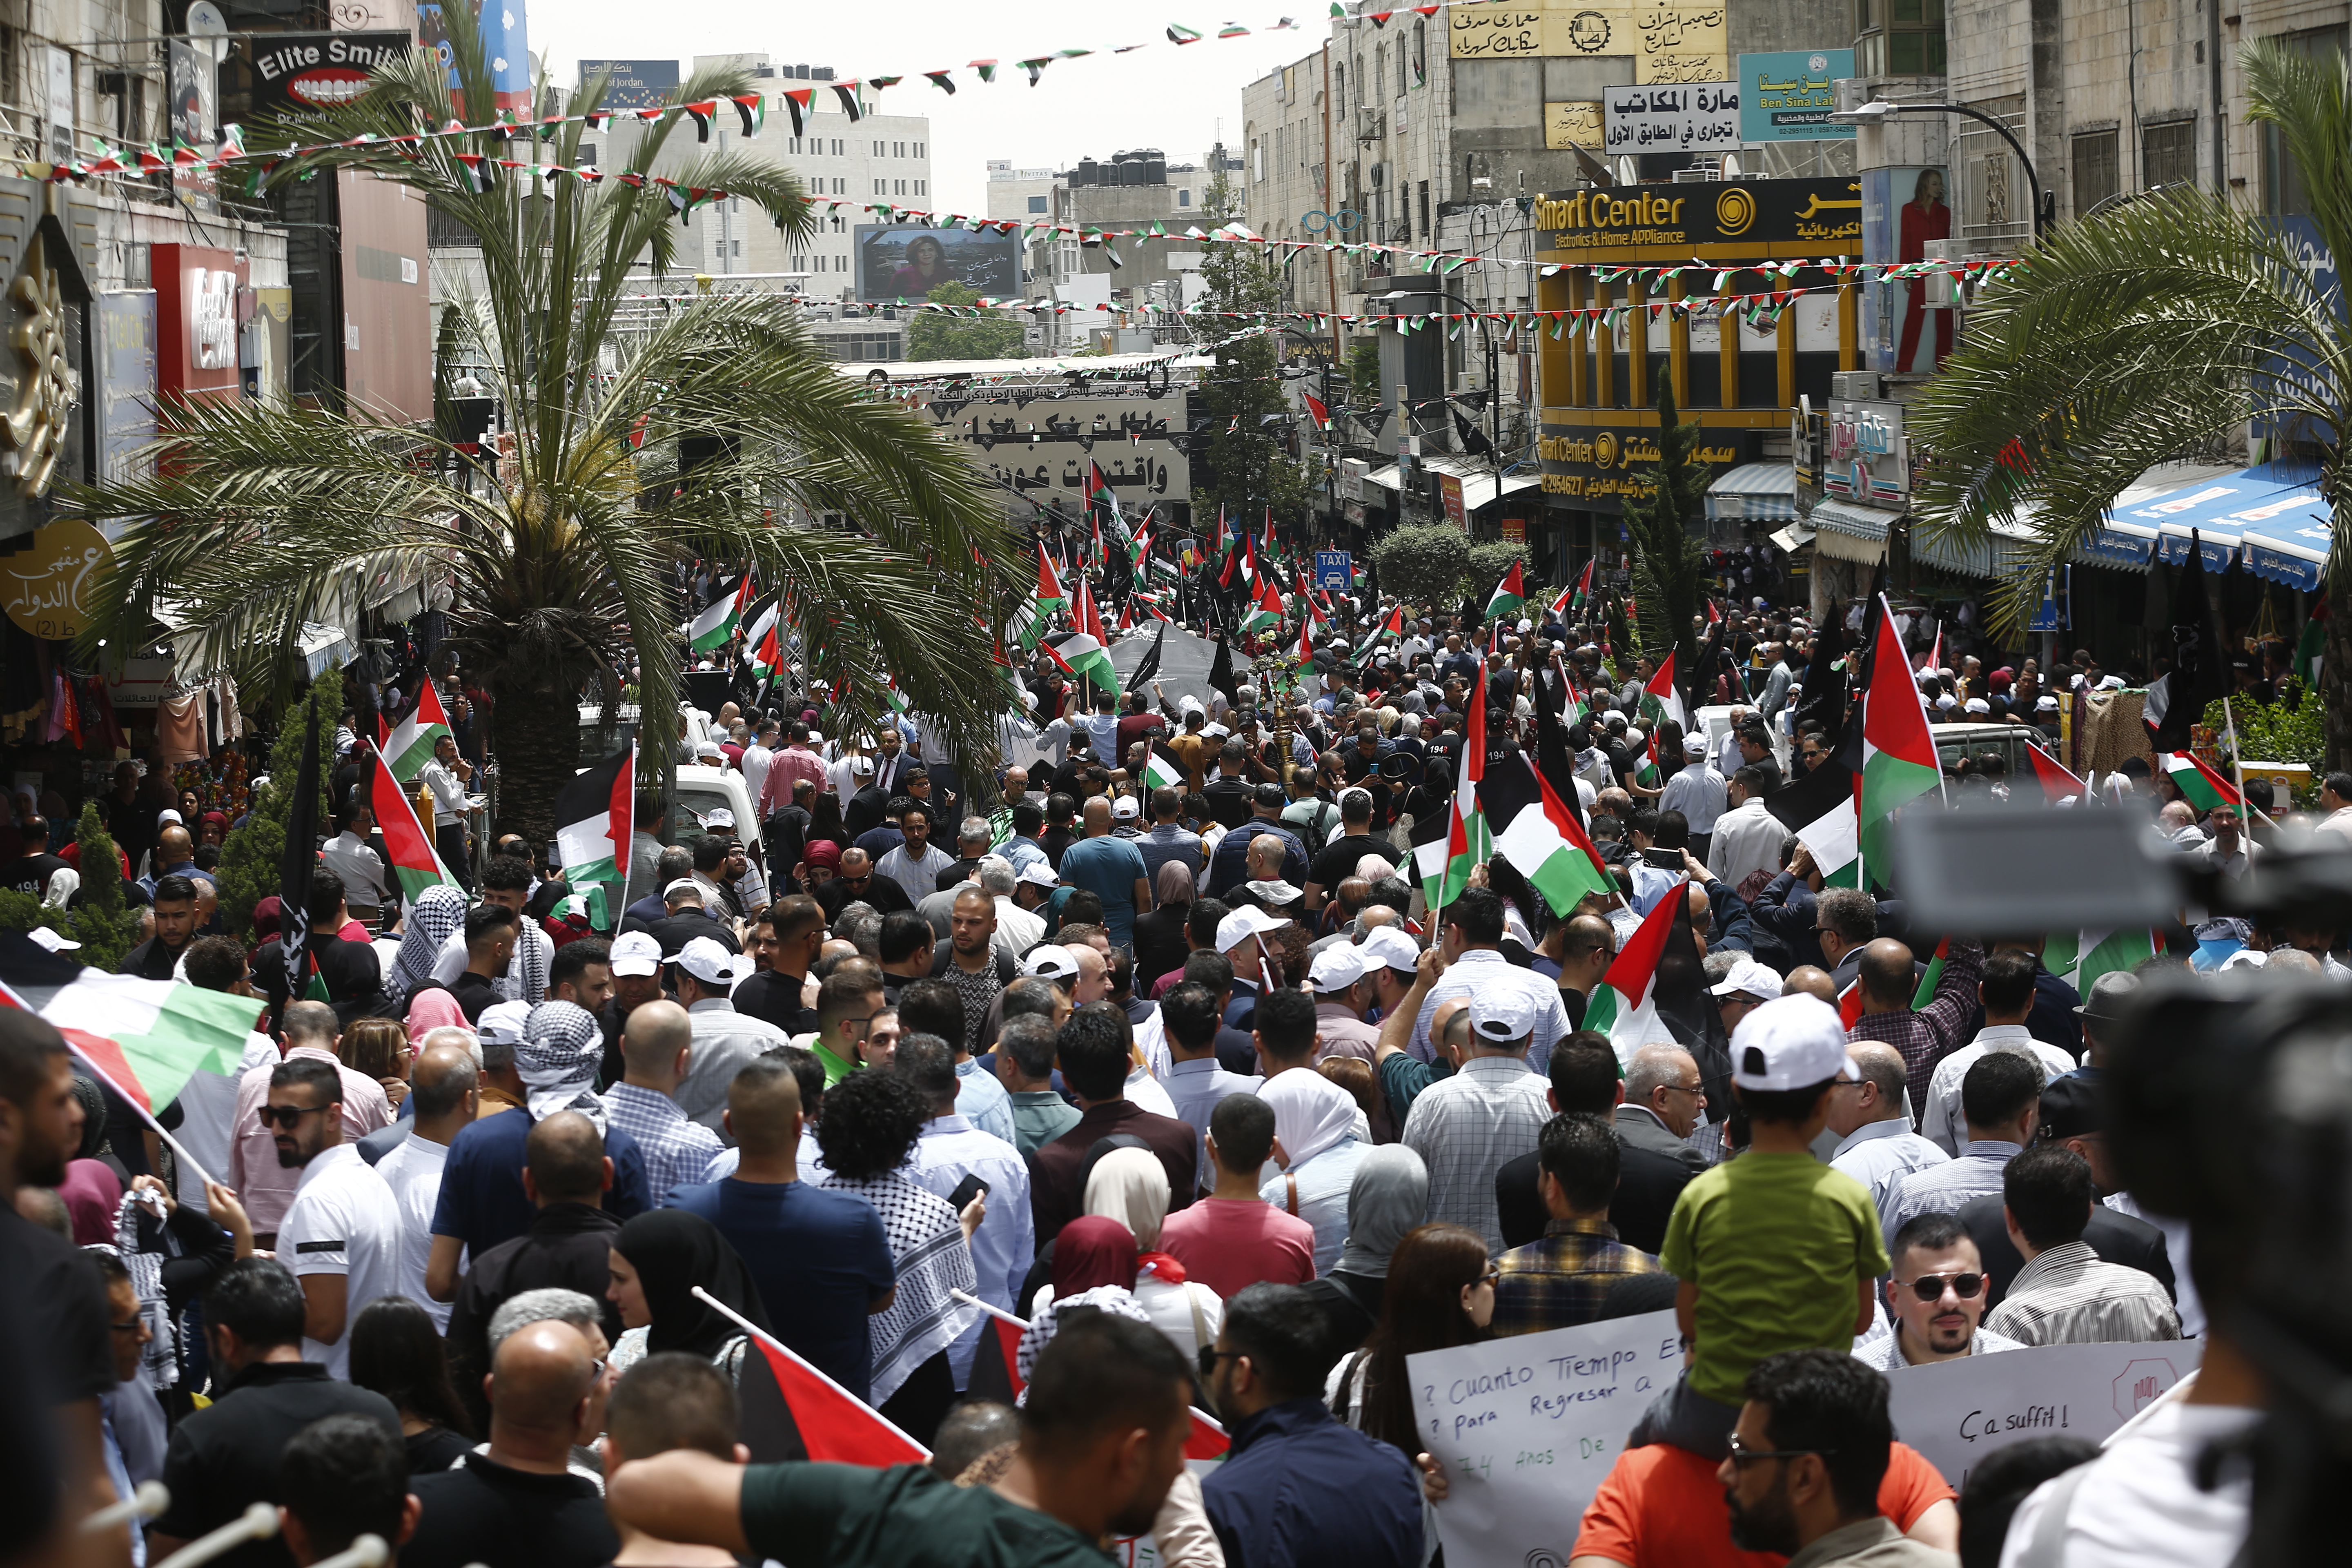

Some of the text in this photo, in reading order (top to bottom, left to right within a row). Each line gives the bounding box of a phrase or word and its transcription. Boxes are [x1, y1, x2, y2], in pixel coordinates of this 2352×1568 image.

[257, 40, 405, 81] Elite Smil
[616, 77, 643, 89] Jordan
[1614, 87, 1739, 119] مارة المكاتب
[1760, 97, 1782, 109] Ben
[1786, 96, 1811, 107] Sina
[1638, 122, 1676, 145] الطابق
[1681, 120, 1694, 149] في
[1535, 189, 1686, 232] Smart Center
[1555, 232, 1592, 249] Electronics
[1592, 233, 1600, 246] &
[1601, 231, 1631, 246] Home
[967, 258, 993, 271] شيرين
[956, 273, 990, 288] صوت فلس
[1539, 434, 1594, 463] Smart Center
[1320, 555, 1345, 566] TAXI
[2175, 543, 2191, 558] طريفي
[4, 579, 68, 617] الدوار
[36, 620, 56, 638] (2)
[1430, 745, 1448, 754] 1948
[1449, 1366, 1534, 1404] Cuanto
[1548, 1349, 1636, 1382] Tiempo
[1530, 1385, 1618, 1419] Regresar
[1580, 1436, 1606, 1460] De
